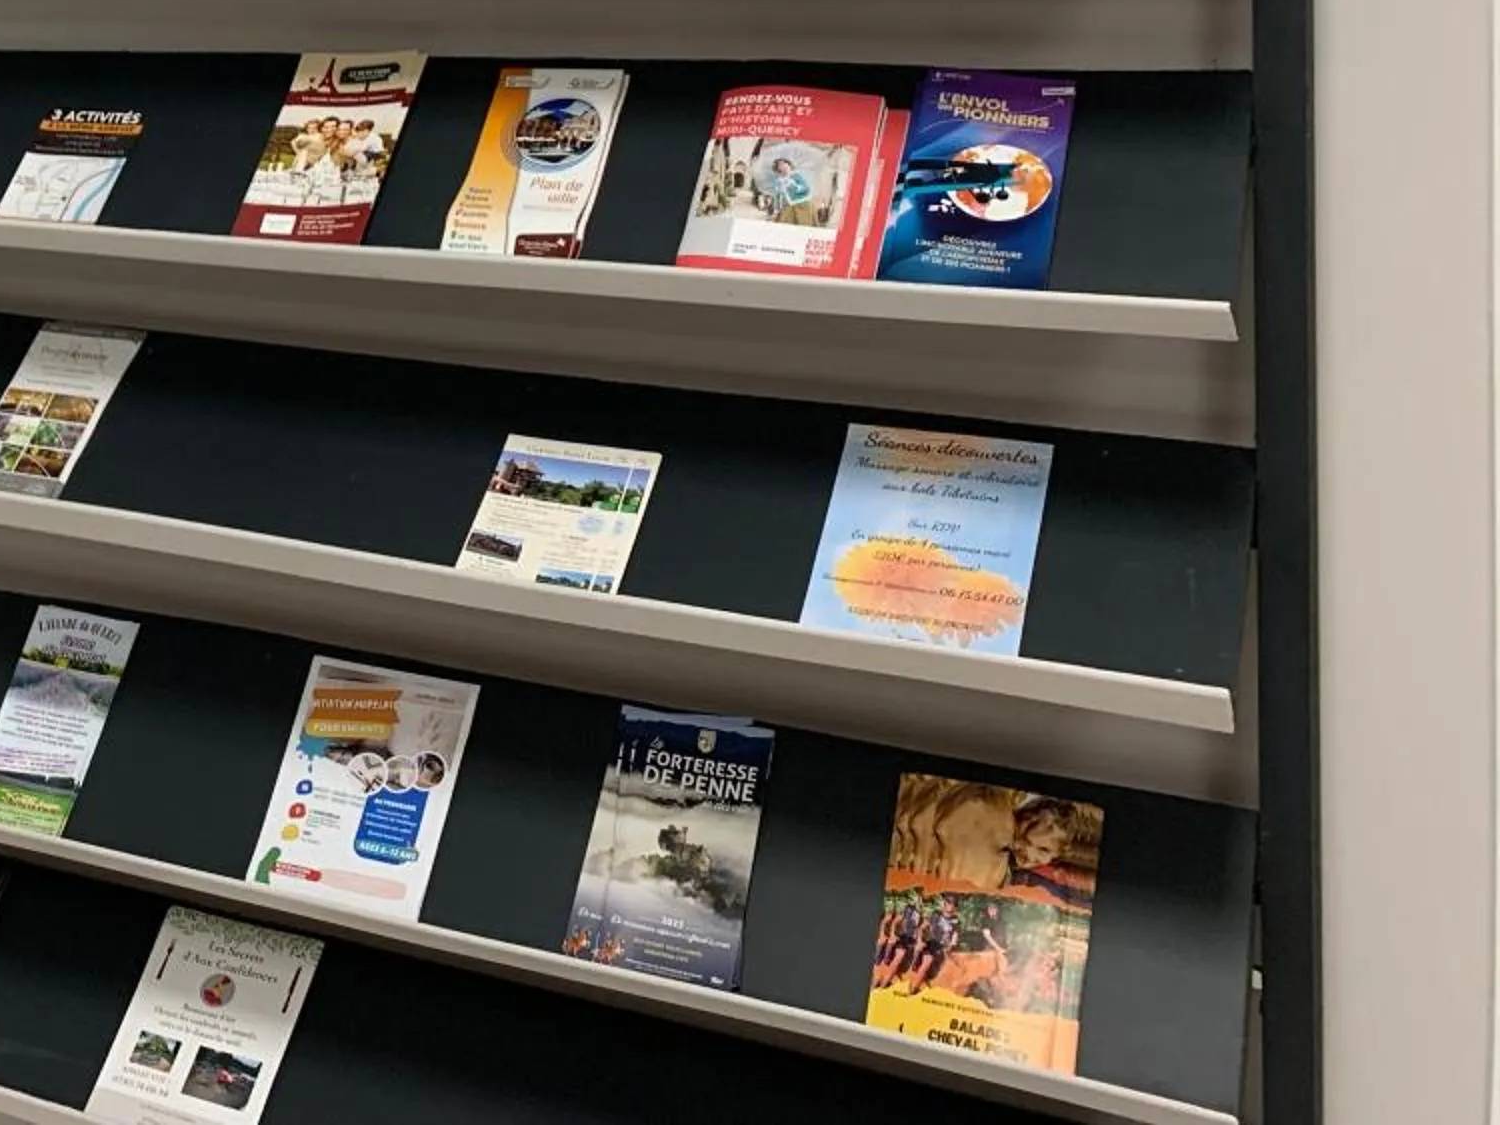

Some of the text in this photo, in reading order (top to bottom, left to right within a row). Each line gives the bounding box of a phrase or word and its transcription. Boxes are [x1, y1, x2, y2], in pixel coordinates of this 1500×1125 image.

[724, 94, 813, 106] RENDEZ-VOUS
[938, 91, 1010, 113] L'ENVOL
[51, 109, 143, 124] 3 ACTIVITÉS
[953, 107, 1050, 129] PIONNIERS
[715, 125, 802, 137] MIDI-QUERCY
[530, 176, 563, 191] Plan
[864, 430, 1040, 465] Séances découvertes
[646, 749, 759, 783] FORTERESSE
[643, 766, 757, 804] DE PENNE
[927, 1029, 981, 1052] CHEVAL
